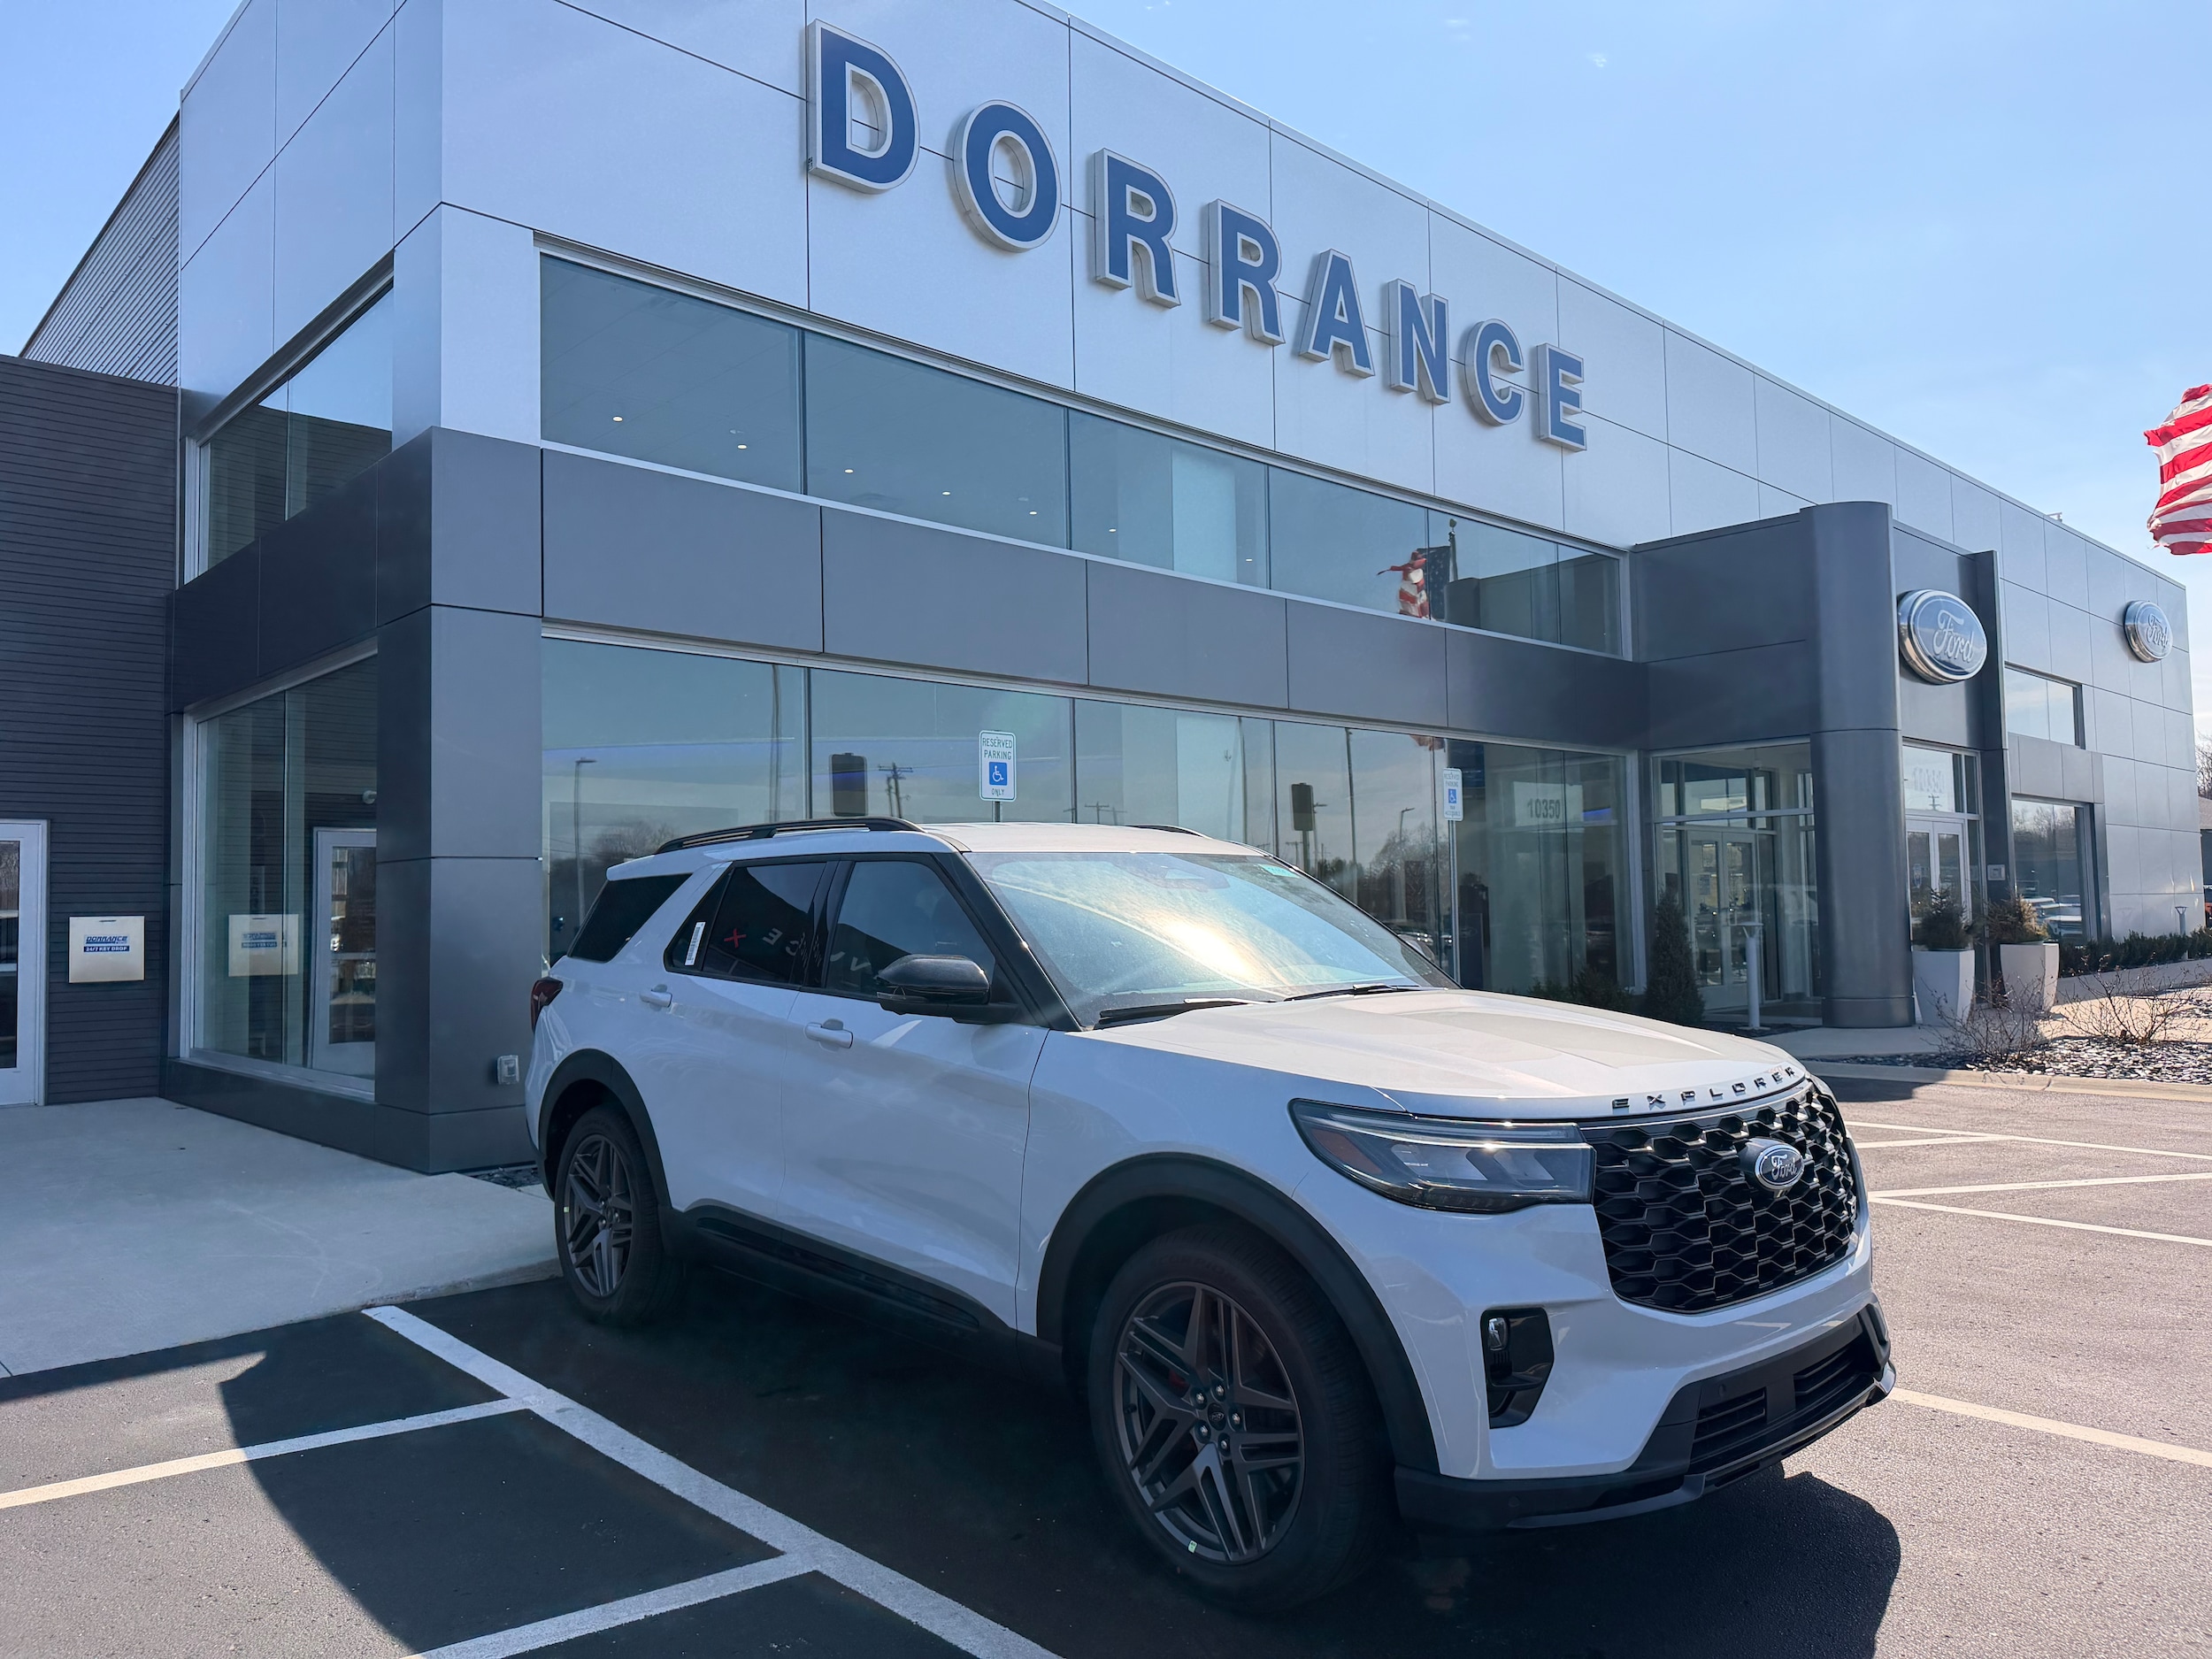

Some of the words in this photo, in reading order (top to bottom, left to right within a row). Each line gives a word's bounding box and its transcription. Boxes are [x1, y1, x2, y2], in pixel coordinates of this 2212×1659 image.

[807, 19, 1586, 451] DORRANCE
[1933, 609, 1975, 663] Ford
[2147, 613, 2169, 649] Ford
[982, 738, 1013, 749] RESERVED
[984, 749, 1011, 760] PARKING
[991, 787, 1004, 796] ONLY
[1527, 798, 1561, 819] 10350
[1612, 1066, 1796, 1108] EXPLORER
[1771, 1154, 1797, 1180] Ford
